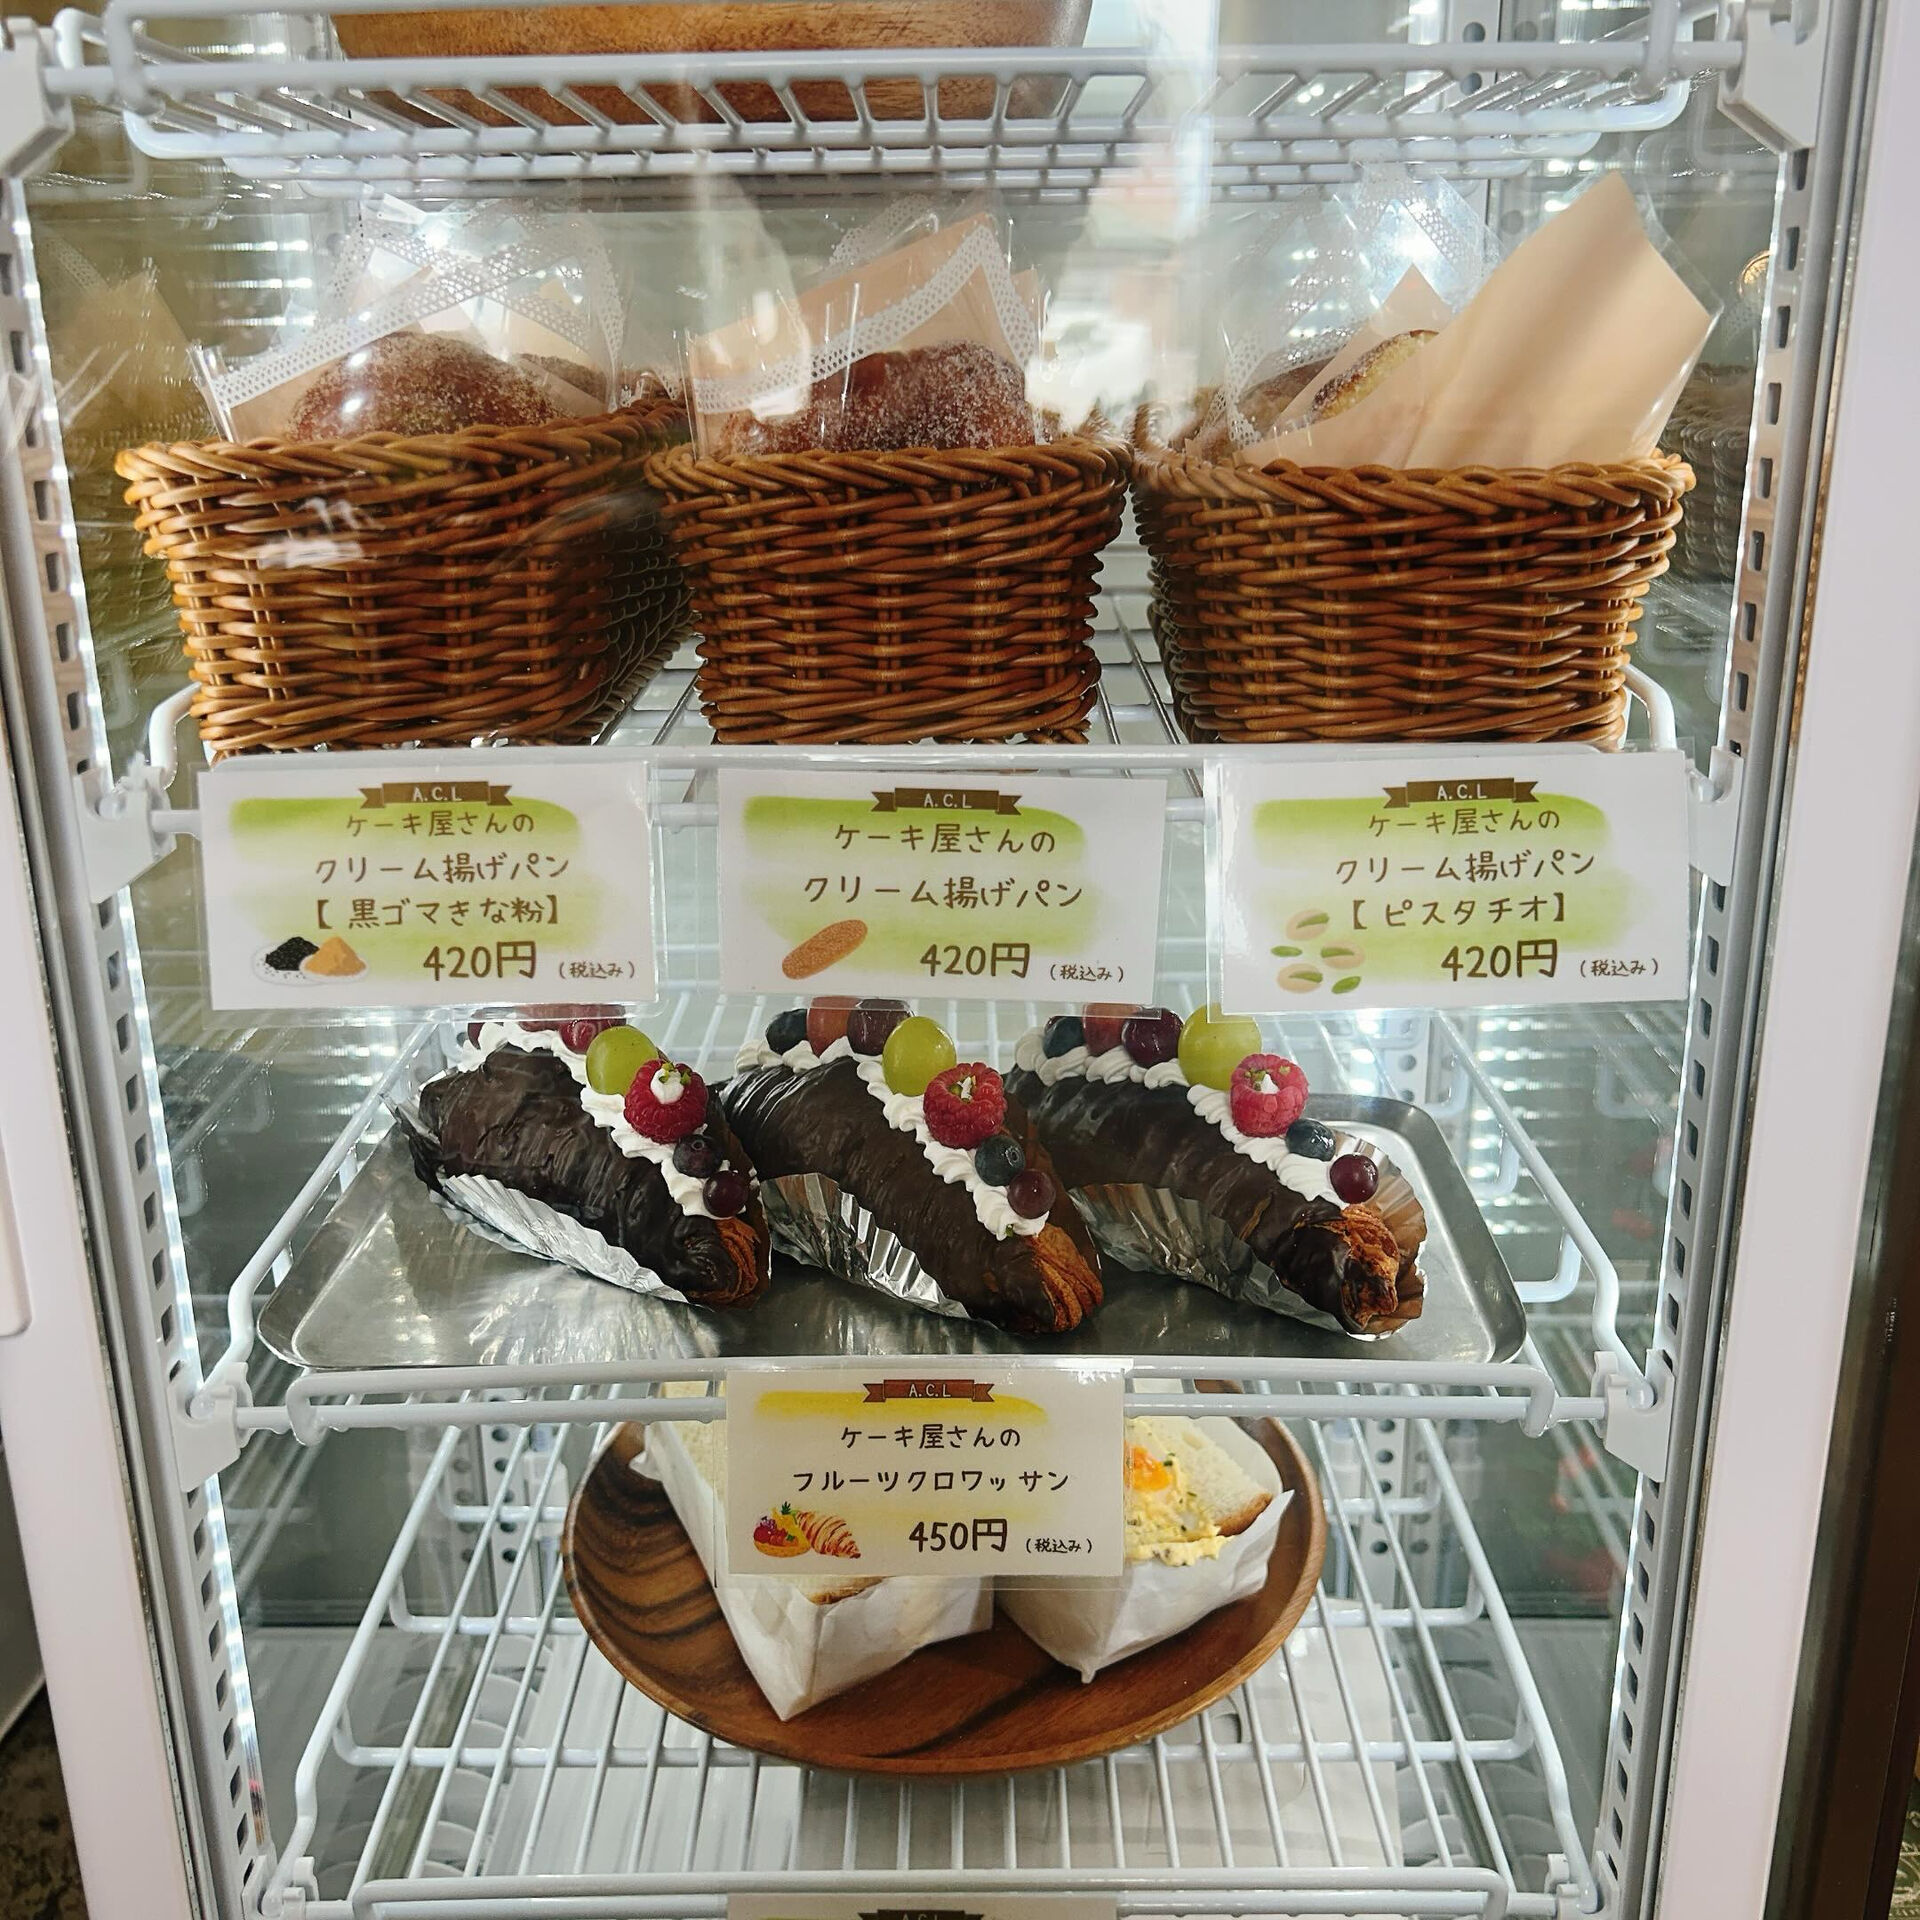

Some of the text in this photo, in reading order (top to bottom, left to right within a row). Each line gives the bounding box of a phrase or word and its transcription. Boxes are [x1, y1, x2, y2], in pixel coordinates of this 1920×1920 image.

[347, 810, 534, 838] ケーキ屋さんの
[1368, 808, 1560, 836] ケーキ屋さんの
[835, 823, 1056, 854] ケーキ屋さんの
[315, 853, 569, 884] クリーム揚げパン
[1336, 849, 1594, 885] クリーム揚げパン
[804, 876, 1082, 908] クリーム揚げパン
[423, 941, 536, 980] 420円
[920, 943, 1030, 979] 420円
[1441, 939, 1558, 981] 420円
[841, 1424, 1021, 1449] ケーキ屋さんの
[793, 1471, 1069, 1492] フルーツクロワッサン
[909, 1518, 1007, 1552] 450円
